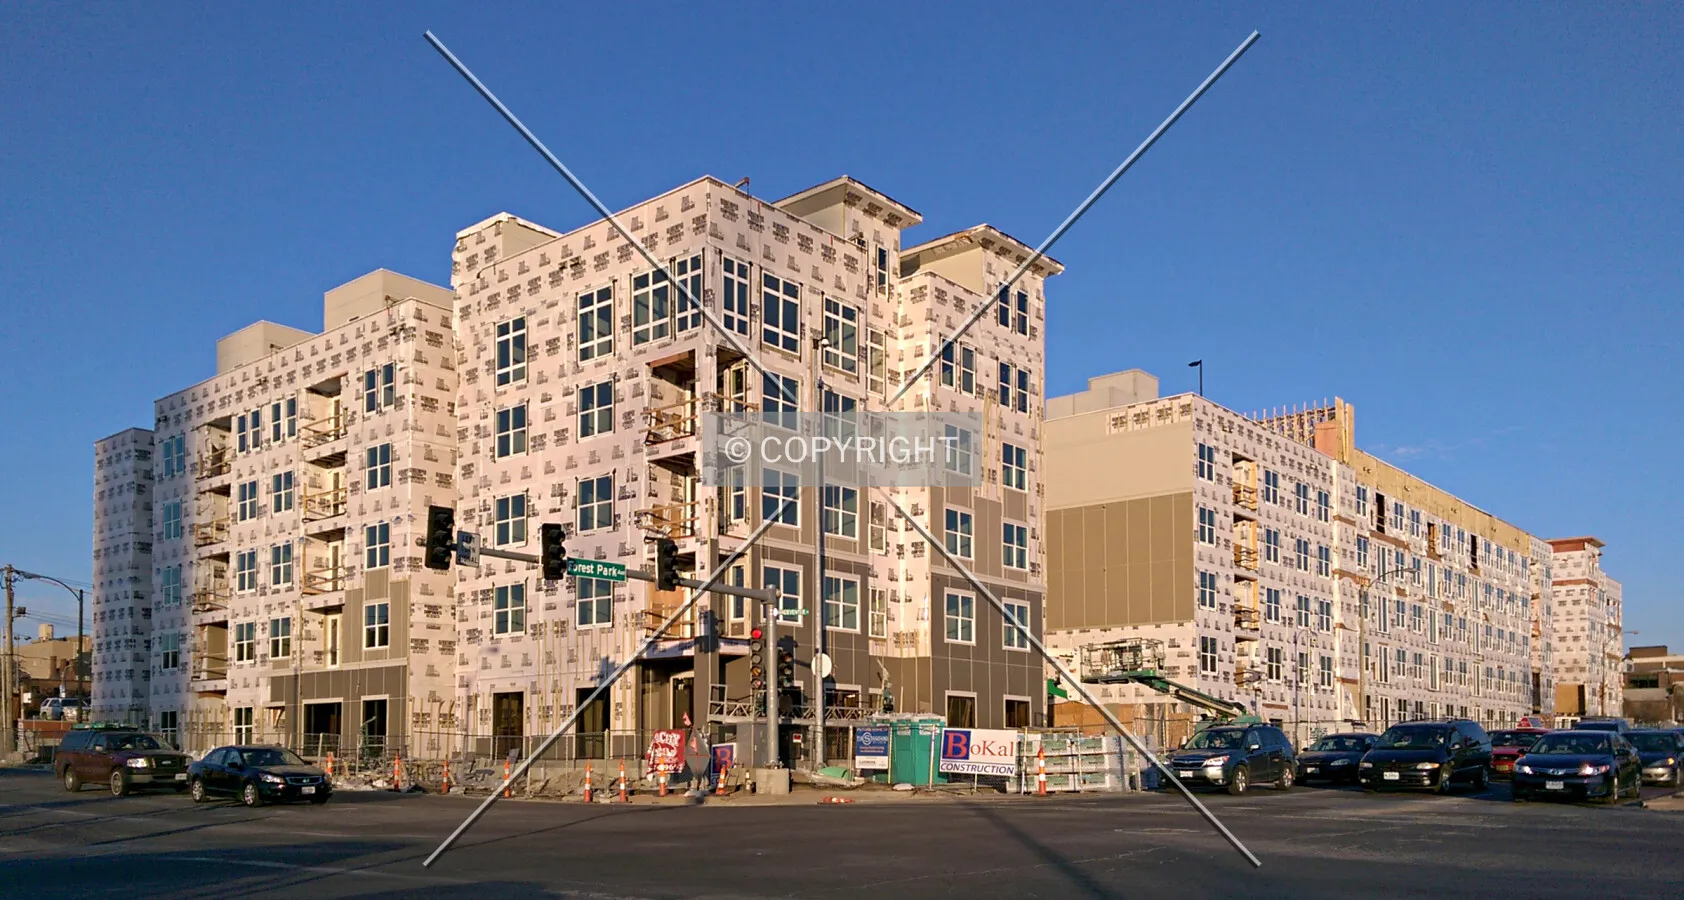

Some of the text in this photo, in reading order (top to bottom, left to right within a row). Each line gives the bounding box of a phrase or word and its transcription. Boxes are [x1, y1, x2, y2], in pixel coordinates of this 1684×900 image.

[568, 560, 594, 575] Forest
[597, 564, 617, 577] Park
[944, 731, 1014, 759] BoKal
[940, 763, 1014, 774] CONSTRUCTION
